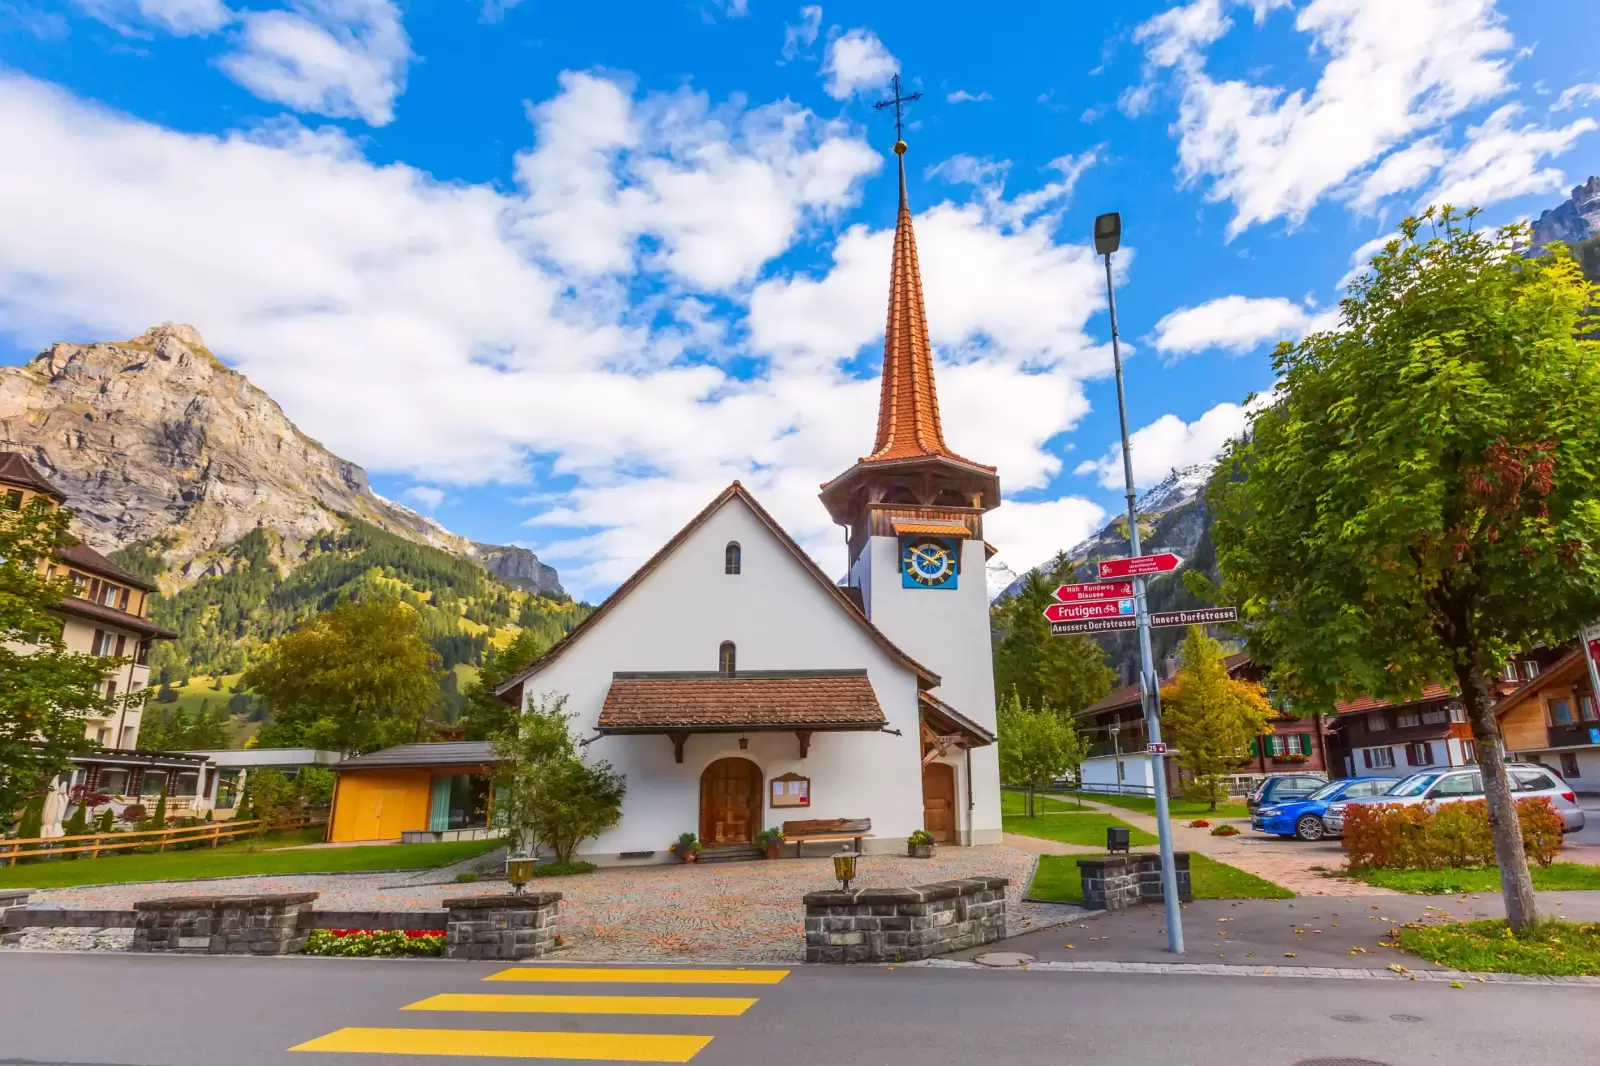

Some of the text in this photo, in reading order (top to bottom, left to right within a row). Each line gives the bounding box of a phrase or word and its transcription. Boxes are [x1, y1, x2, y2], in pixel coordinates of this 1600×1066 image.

[1084, 584, 1114, 592] Rundweg
[1058, 605, 1102, 618] Frutigen
[1152, 611, 1235, 625] Innere Dorfstrasse
[1052, 620, 1136, 633] Aeussere Dorfstrasse
